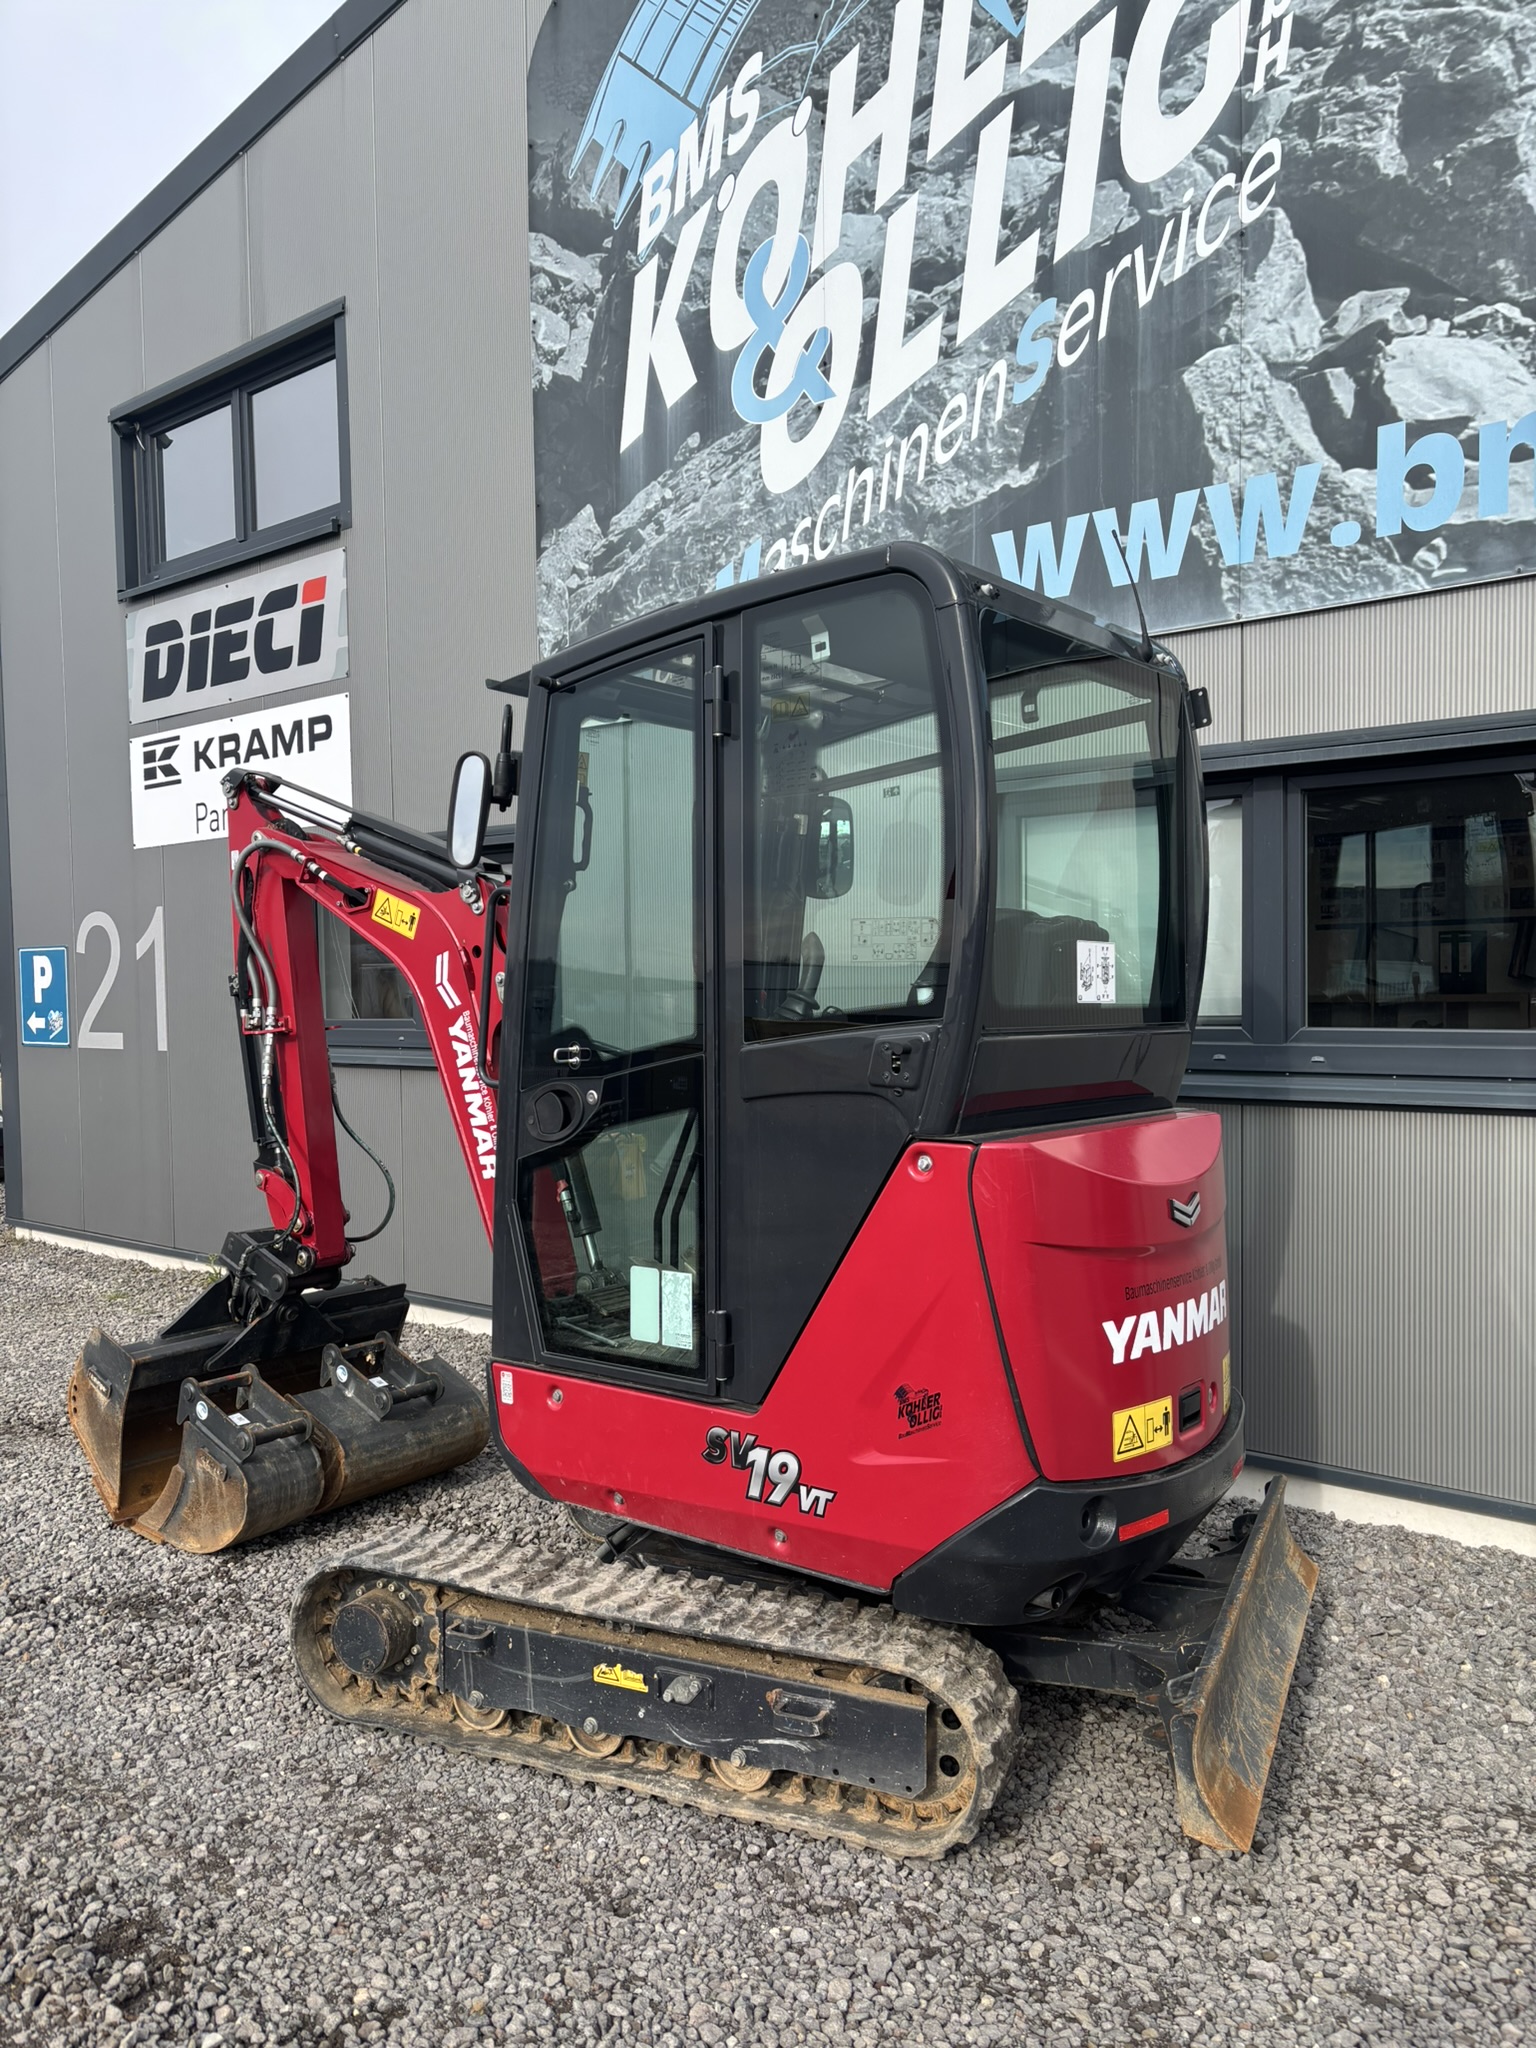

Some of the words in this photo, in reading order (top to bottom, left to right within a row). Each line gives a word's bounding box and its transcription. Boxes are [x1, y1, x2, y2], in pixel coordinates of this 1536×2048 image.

[638, 51, 763, 255] BMS
[731, 233, 837, 424] &
[194, 714, 333, 772] KRAMP
[33, 955, 53, 1004] P
[76, 906, 168, 1051] 21
[448, 1015, 497, 1180] YANMAR
[1101, 1279, 1227, 1365] YANMAR
